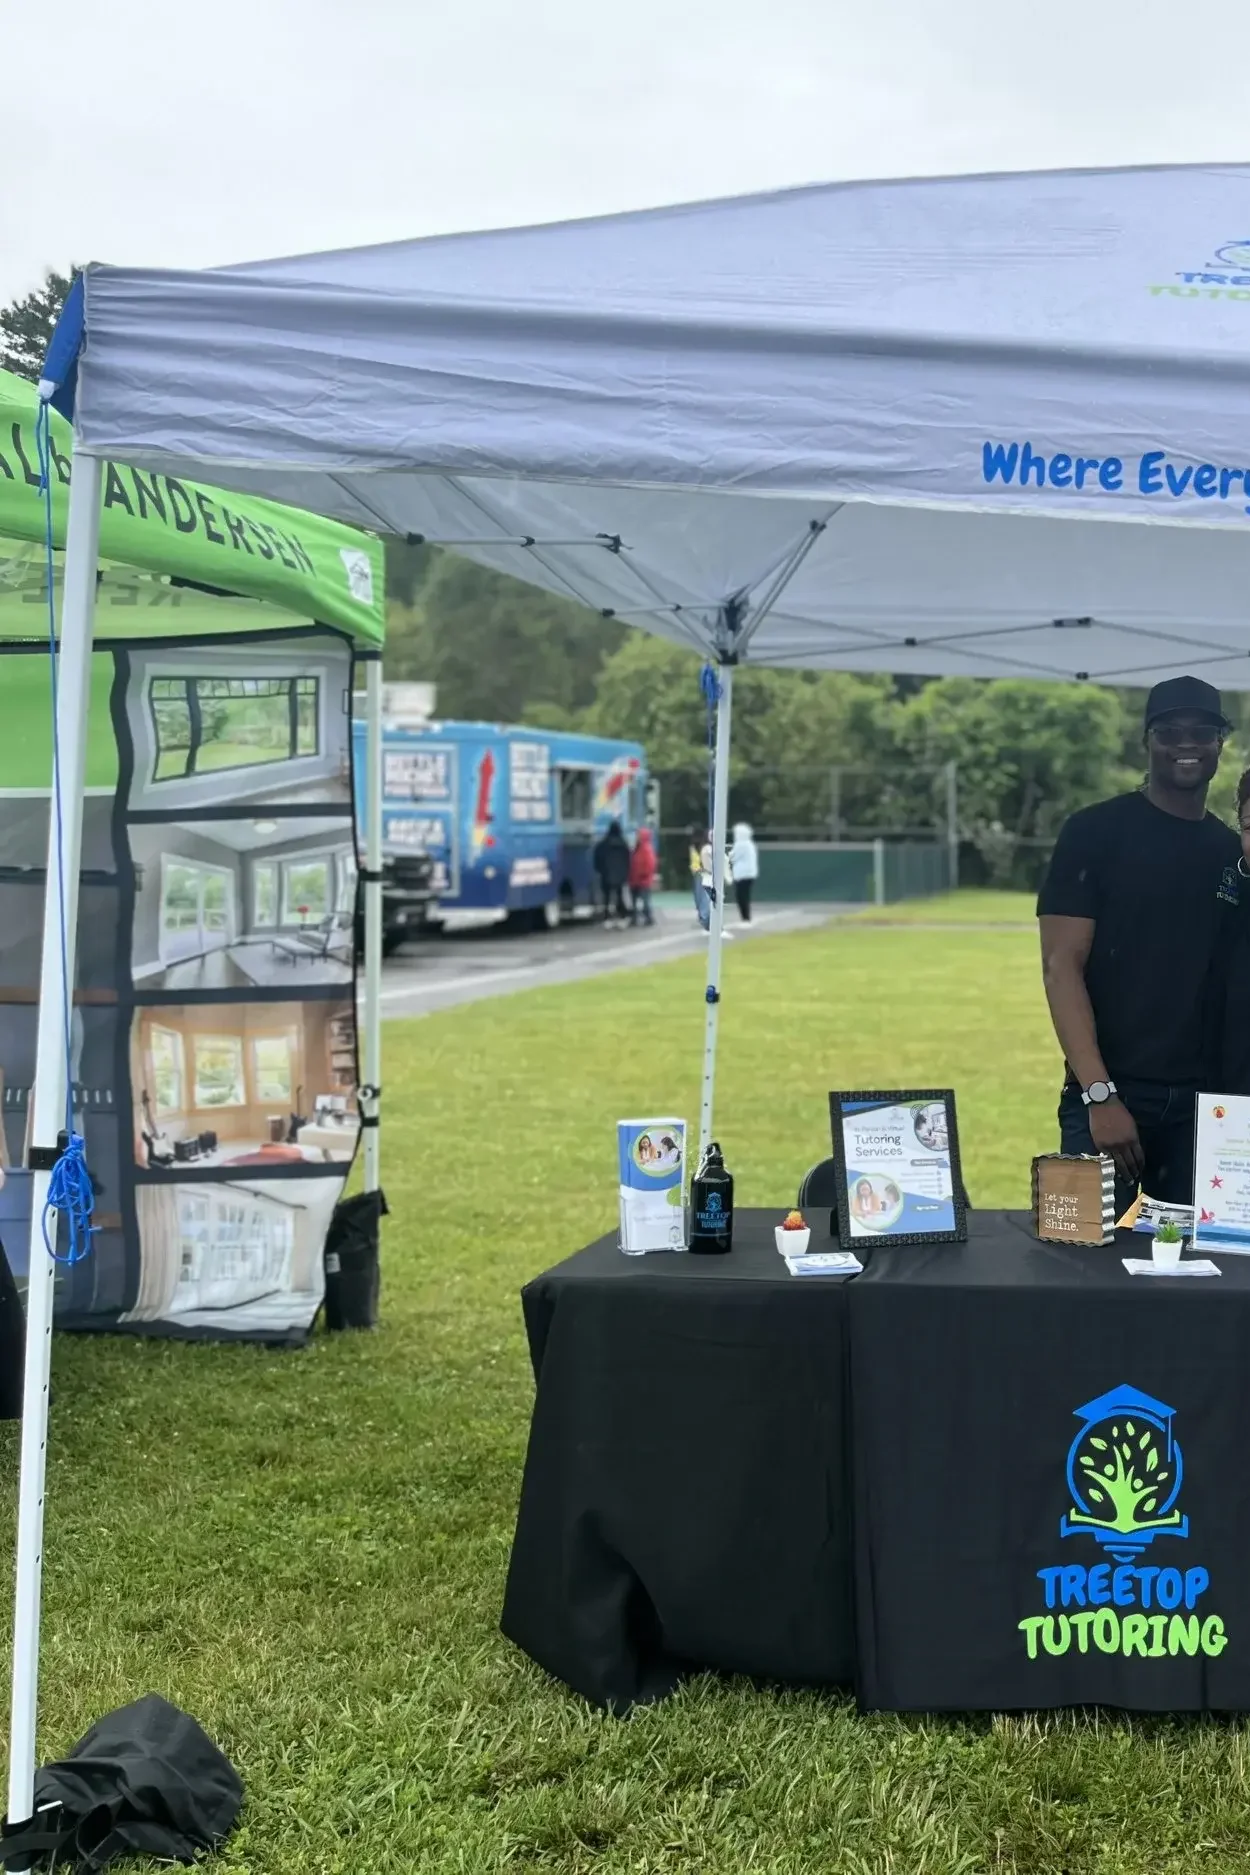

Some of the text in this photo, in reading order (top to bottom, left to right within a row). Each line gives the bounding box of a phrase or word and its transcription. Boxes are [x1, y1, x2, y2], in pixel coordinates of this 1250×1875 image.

[982, 441, 1124, 491] Where
[103, 461, 318, 580] ANDERSEN
[854, 1133, 901, 1146] Tutoring
[855, 1146, 903, 1157] Services
[1044, 1193, 1079, 1204] Let your
[1044, 1203, 1079, 1219] Light
[1045, 1219, 1079, 1232] Shine.
[1037, 1563, 1209, 1610] TREETOP
[1018, 1607, 1229, 1659] TUTORING
